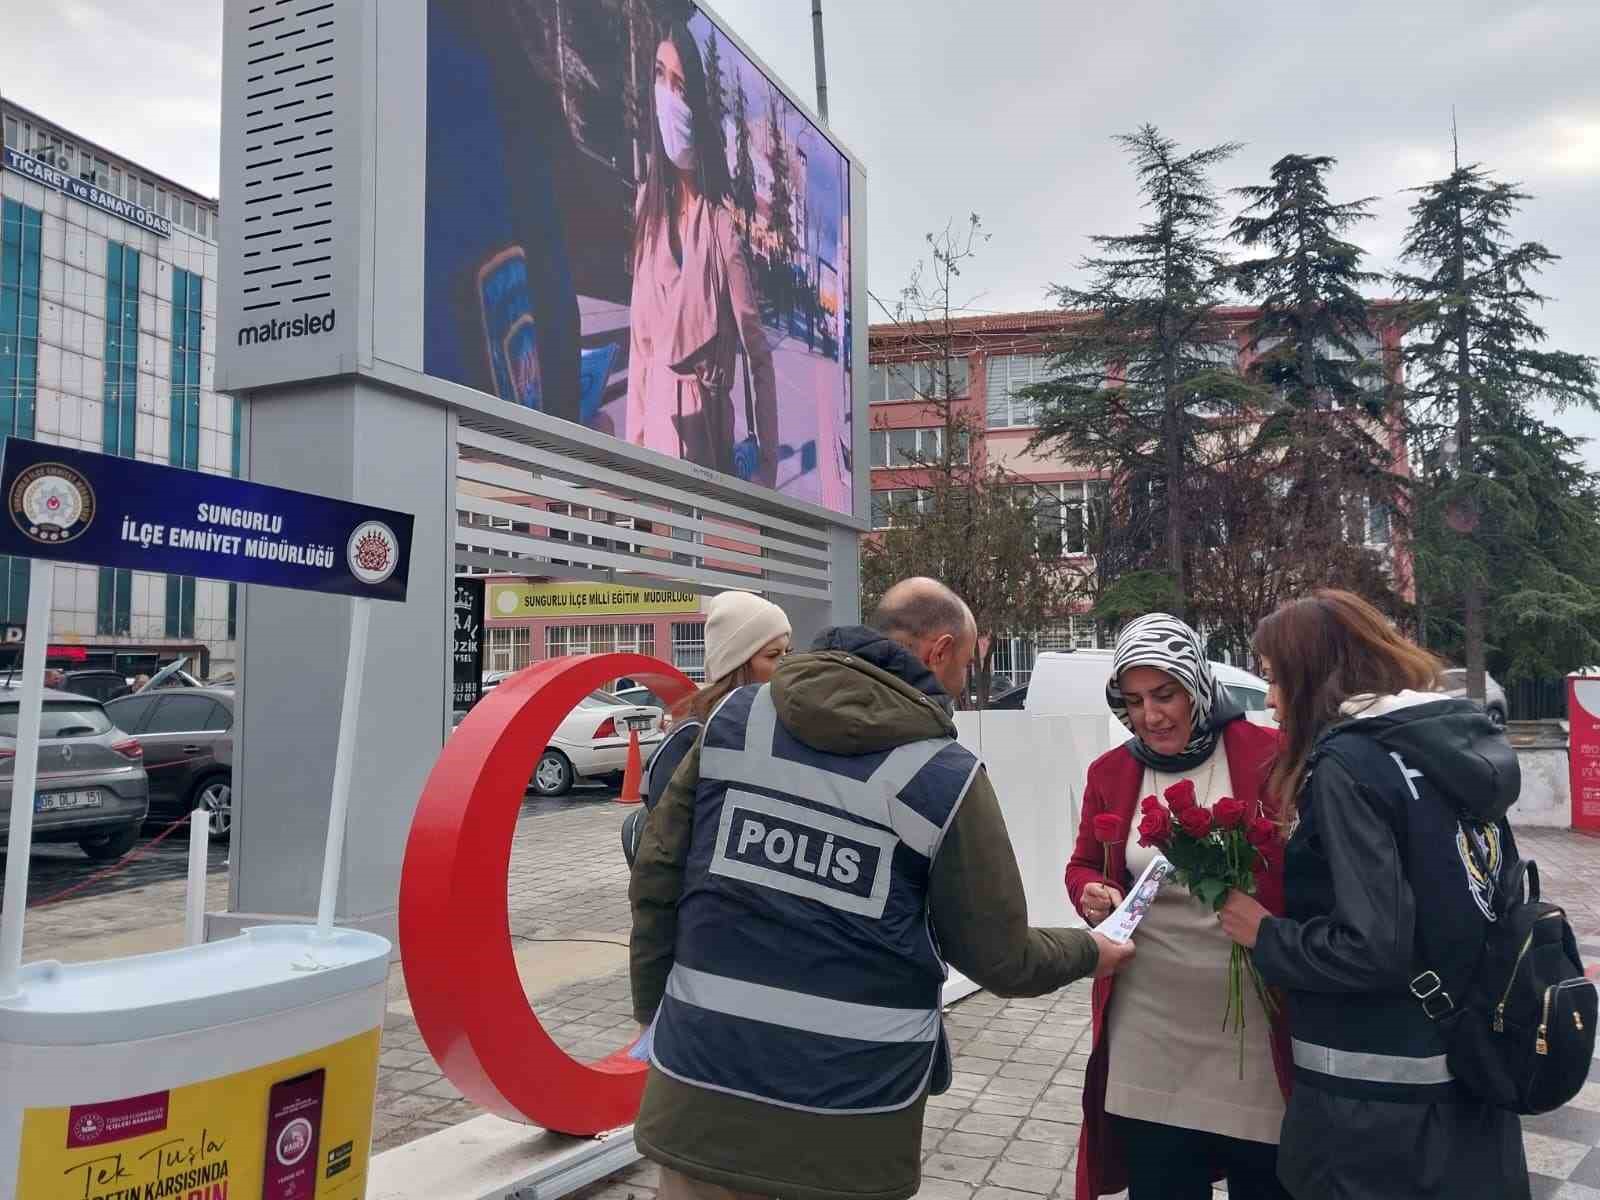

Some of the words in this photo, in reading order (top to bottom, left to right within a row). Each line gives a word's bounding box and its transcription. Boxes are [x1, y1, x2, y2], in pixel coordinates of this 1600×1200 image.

[10, 152, 71, 189] TİCARET
[72, 183, 87, 196] ve
[89, 188, 135, 218] SANAYİ
[136, 209, 171, 234] ODASI
[238, 308, 335, 346] matrisled
[197, 502, 282, 534] SUNGURLU
[121, 515, 165, 548] İLÇE
[169, 528, 241, 556] EMNİYET
[244, 536, 335, 569] MÜDÜRLÜĞÜ
[524, 594, 568, 607] SUNGURLU
[569, 592, 587, 608] İLÇE
[589, 591, 610, 605] MİLLİ
[612, 590, 640, 604] EĞİTİM
[737, 819, 862, 884] POLİS
[64, 1153, 131, 1197] Tek
